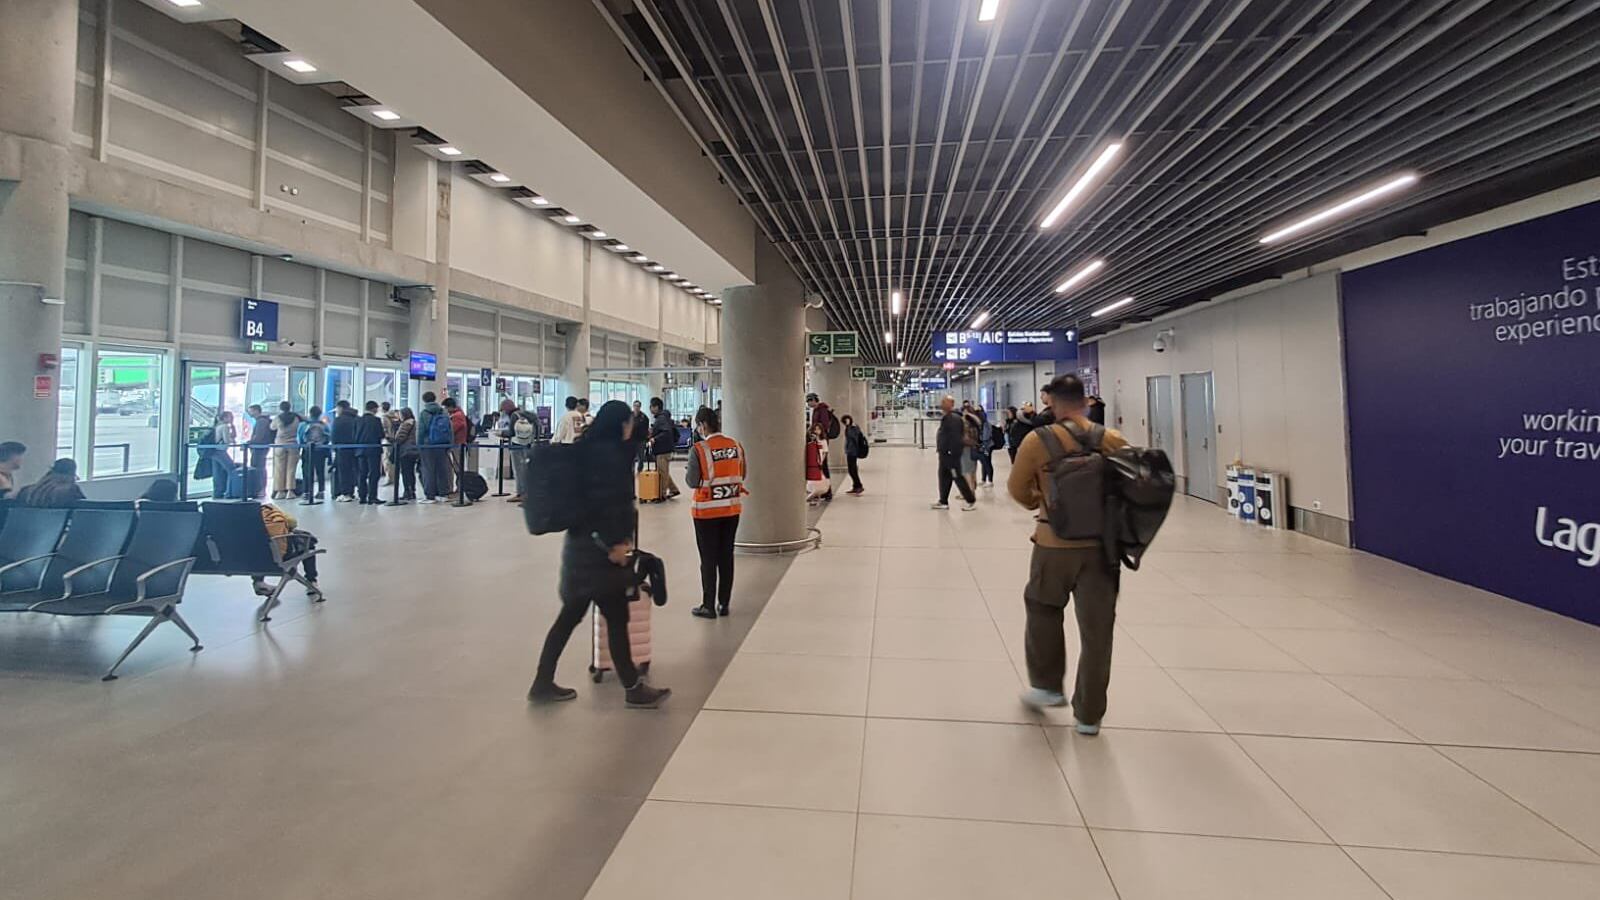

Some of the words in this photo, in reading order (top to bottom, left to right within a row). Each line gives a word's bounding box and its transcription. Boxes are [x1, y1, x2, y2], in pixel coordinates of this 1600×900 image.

[1562, 256, 1600, 281] Est
[1470, 285, 1587, 321] trabajando
[247, 320, 264, 337] B4
[1522, 408, 1600, 432] workin
[1498, 437, 1549, 458] your
